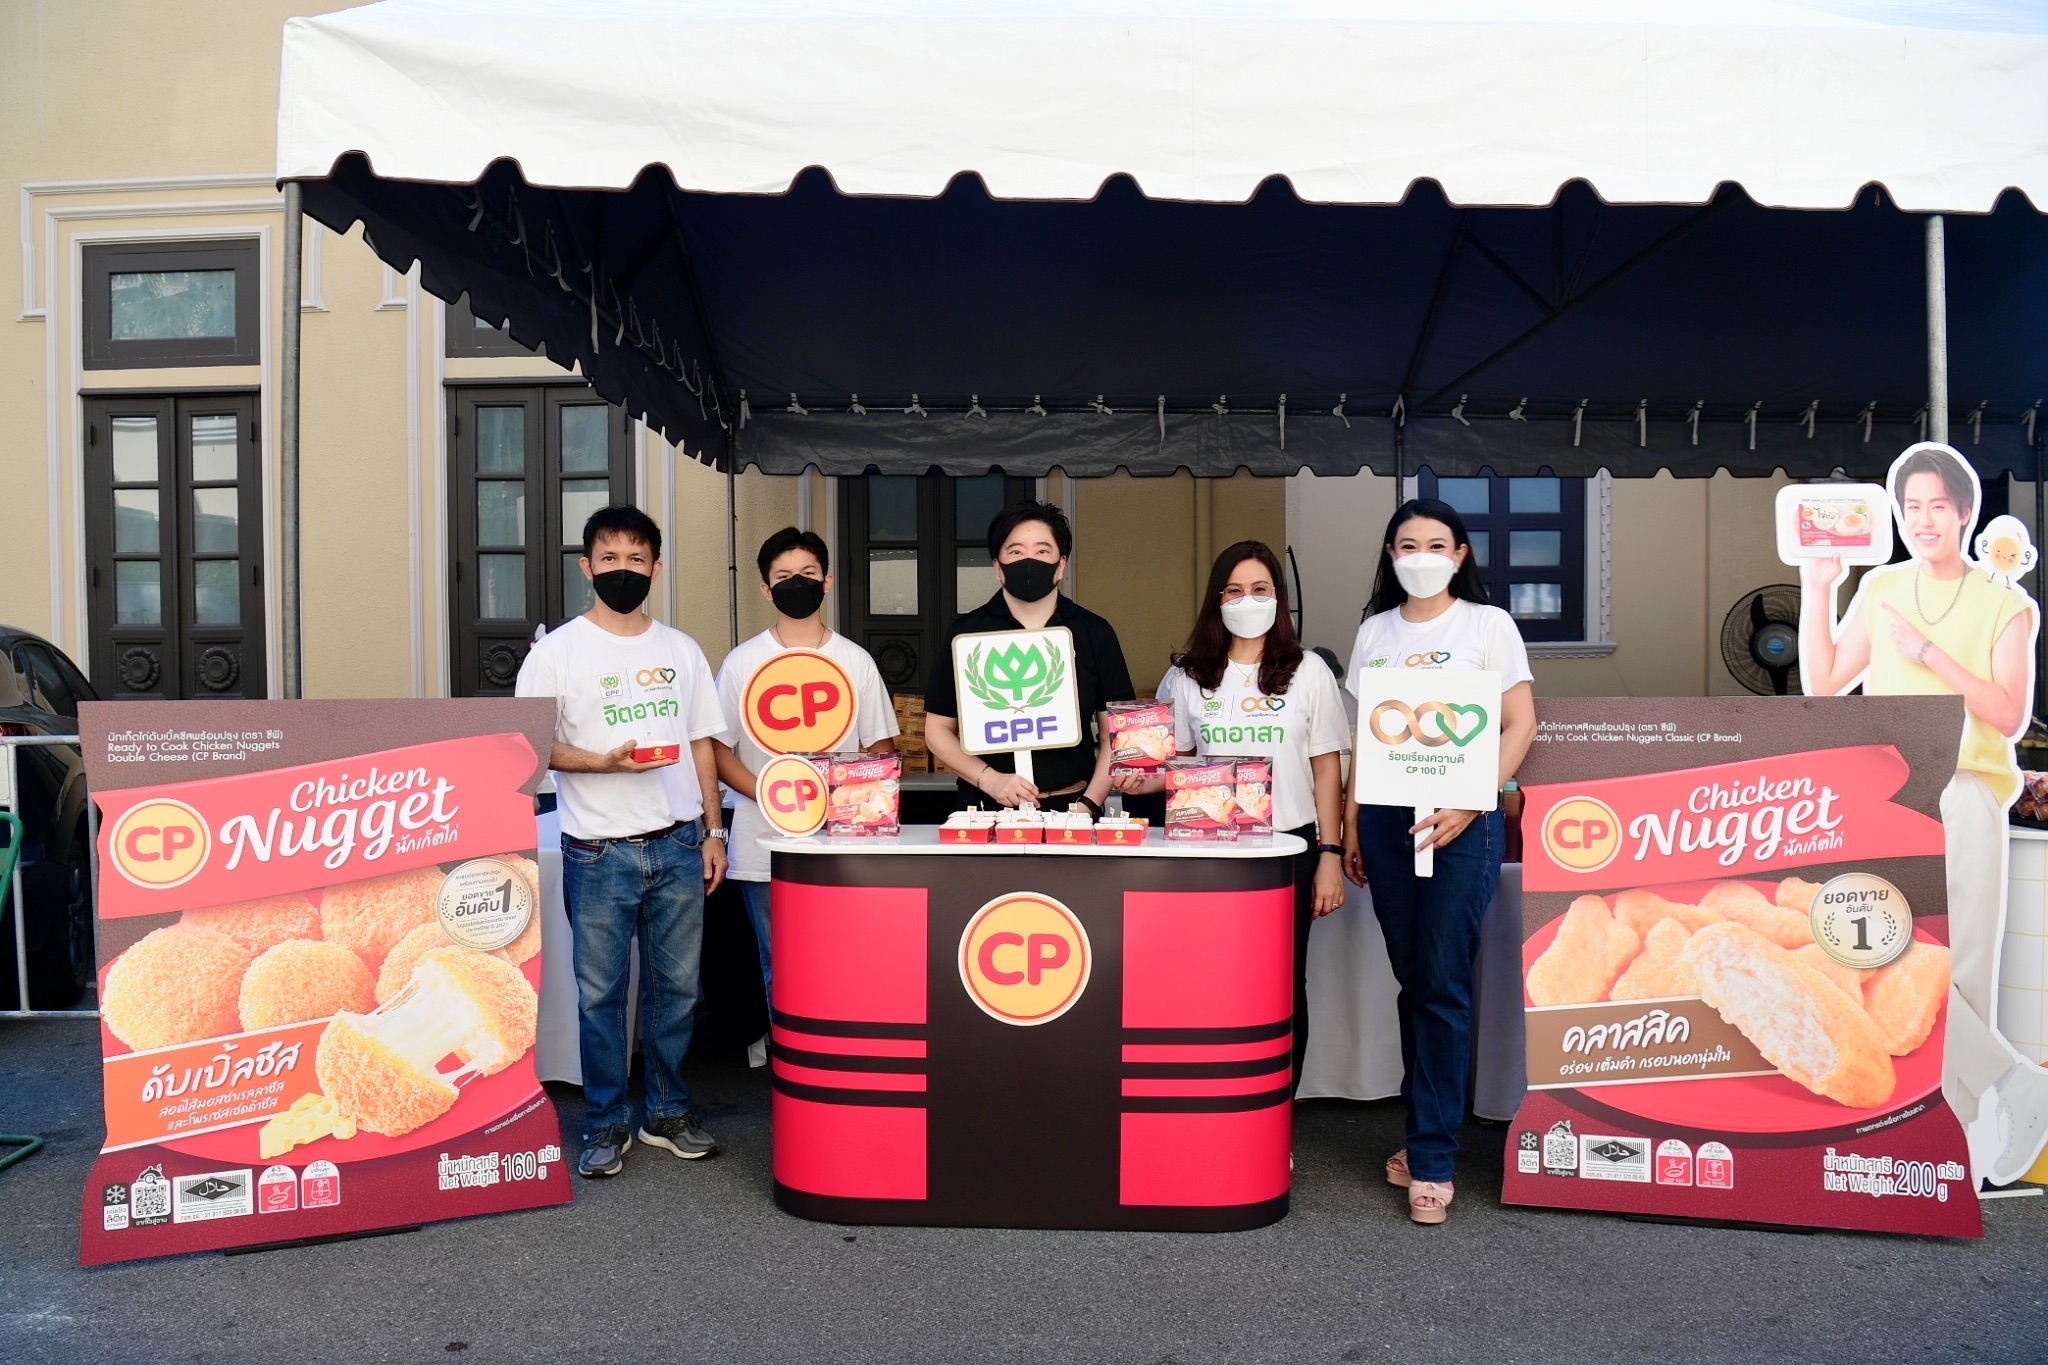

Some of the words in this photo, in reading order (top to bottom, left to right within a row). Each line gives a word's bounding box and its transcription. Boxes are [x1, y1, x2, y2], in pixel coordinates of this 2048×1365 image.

[605, 689, 620, 697] CPF
[757, 681, 840, 731] CP
[603, 699, 679, 726] จิตอาสา
[1126, 712, 1158, 727] Nugget
[984, 715, 1059, 744] CPF
[1200, 723, 1285, 744] จิตอาสา
[1555, 732, 1565, 741] to
[1566, 732, 1589, 742] Cook
[1591, 732, 1624, 742] Chicken
[1626, 732, 1663, 744] Nuggets
[1665, 732, 1695, 742] Classic
[1696, 732, 1711, 743] (CP
[1713, 732, 1742, 743] Brand)
[107, 741, 142, 754] Ready
[146, 742, 158, 751] to
[161, 741, 189, 751] Cook
[192, 740, 233, 751] Chicken
[236, 740, 281, 752] Nuggets
[107, 751, 146, 763] Double
[149, 751, 189, 762] Cheese
[192, 751, 209, 762] (CP
[212, 750, 246, 761] Brand)
[1388, 750, 1465, 764] ร้อยเรียงความดี
[847, 765, 883, 779] Nugget
[1187, 771, 1221, 784] Nugget
[1405, 766, 1418, 774] CP
[1420, 766, 1437, 775] 100
[1438, 764, 1446, 775] ปี
[290, 767, 431, 812] Chicken
[767, 779, 819, 813] CP
[1688, 775, 1817, 814] Chicken
[125, 825, 195, 863] CP
[219, 776, 459, 870] Nugget
[1552, 819, 1610, 849] CP
[1628, 786, 1844, 867] Nugget
[394, 824, 460, 854] นักเก็ตไก่
[1782, 830, 1845, 857] นักเก็ตไก่
[455, 897, 500, 917] อันดับ
[495, 878, 512, 914] 1
[461, 890, 494, 901] ยอดขาย
[1823, 889, 1889, 904] ยอดขาย
[1845, 903, 1873, 914] อันดับ
[1850, 916, 1873, 950] 1
[977, 931, 1071, 986] CP
[1562, 1008, 1691, 1055] คลาสสิค
[141, 1041, 304, 1103] ดับเบิ้ลชีส
[1559, 1058, 1594, 1076] อร่อย
[1595, 1054, 1636, 1072] เต็มคำ
[1638, 1044, 1731, 1070] กรอบนอกนุ่มใน
[438, 1152, 499, 1176] น้ำหนักสุทธิ
[502, 1152, 536, 1182] 160
[538, 1145, 560, 1163] กรัม
[1602, 1144, 1630, 1157] حلال
[439, 1175, 459, 1190] Net
[460, 1170, 500, 1187] Weight
[538, 1165, 547, 1180] g
[1824, 1148, 1892, 1177] น้ำหนักสุทธิ
[1894, 1160, 1935, 1197] 200
[1937, 1161, 1965, 1180] กรัม
[198, 1181, 230, 1196] حلال
[1824, 1171, 1847, 1191] Net
[1849, 1173, 1895, 1197] Weight
[1937, 1184, 1948, 1202] g
